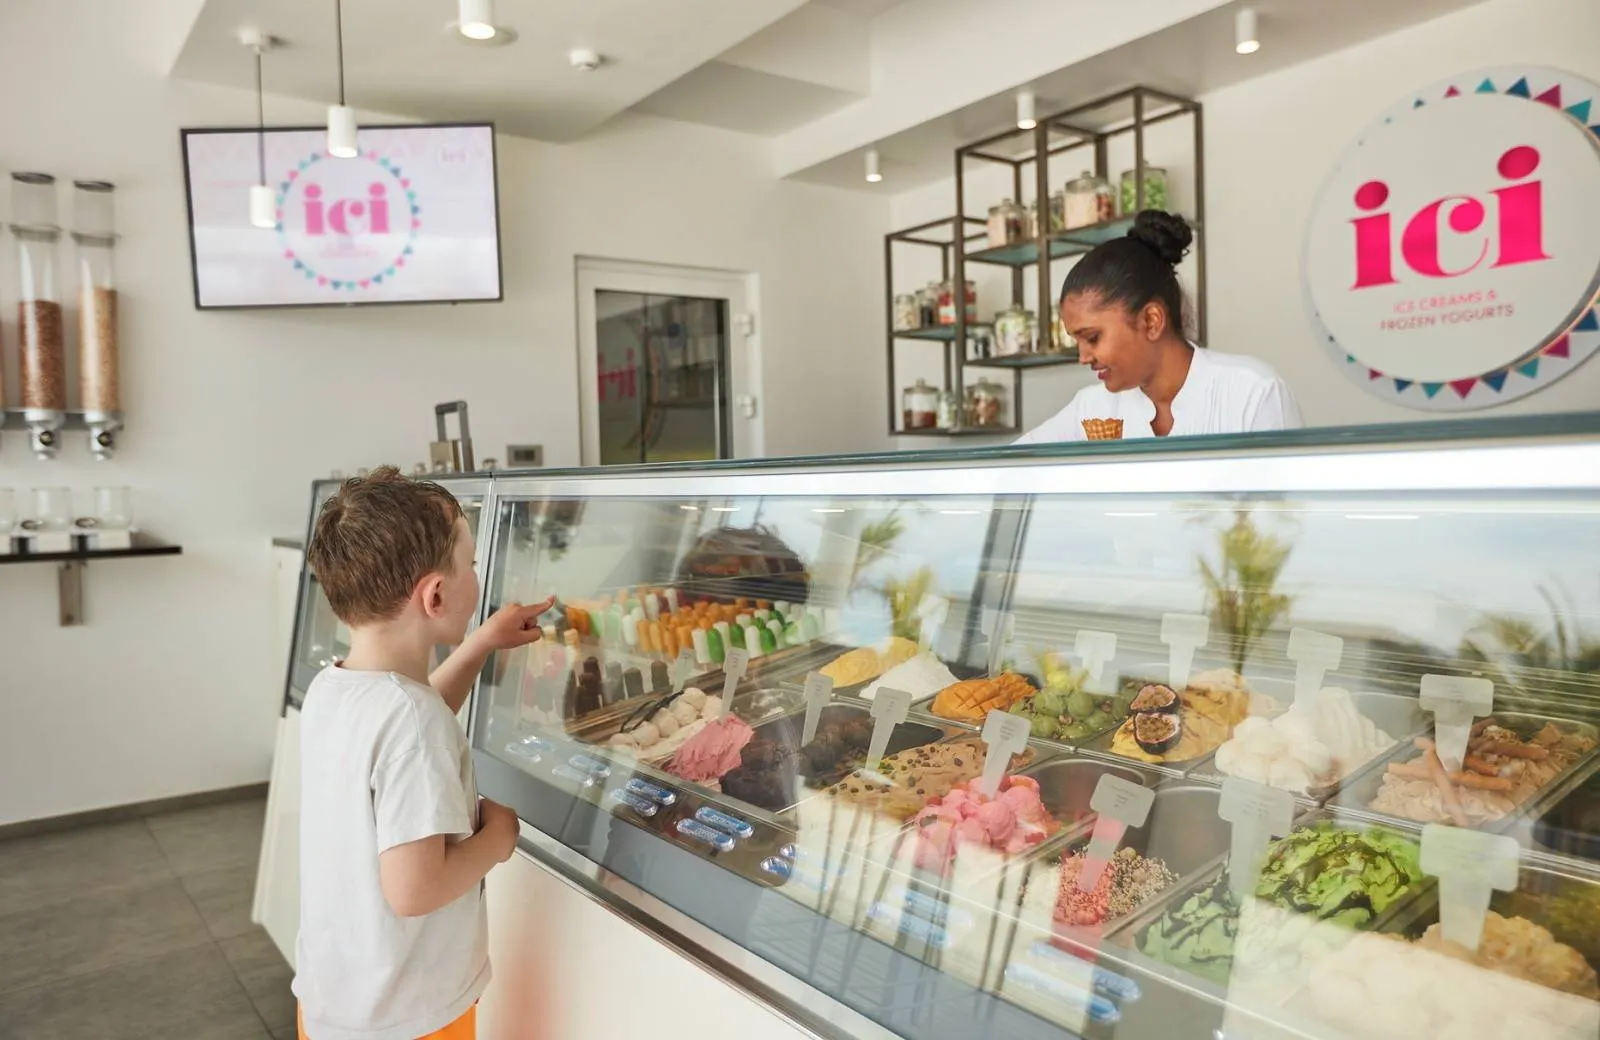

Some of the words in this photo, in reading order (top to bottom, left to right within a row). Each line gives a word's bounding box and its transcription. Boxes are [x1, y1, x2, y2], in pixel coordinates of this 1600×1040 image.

[303, 182, 390, 236] ici
[1346, 144, 1554, 290] ici
[1379, 315, 1436, 331] FROZEN
[1440, 303, 1514, 323] YOGURTS
[1419, 290, 1482, 311] CREAMS
